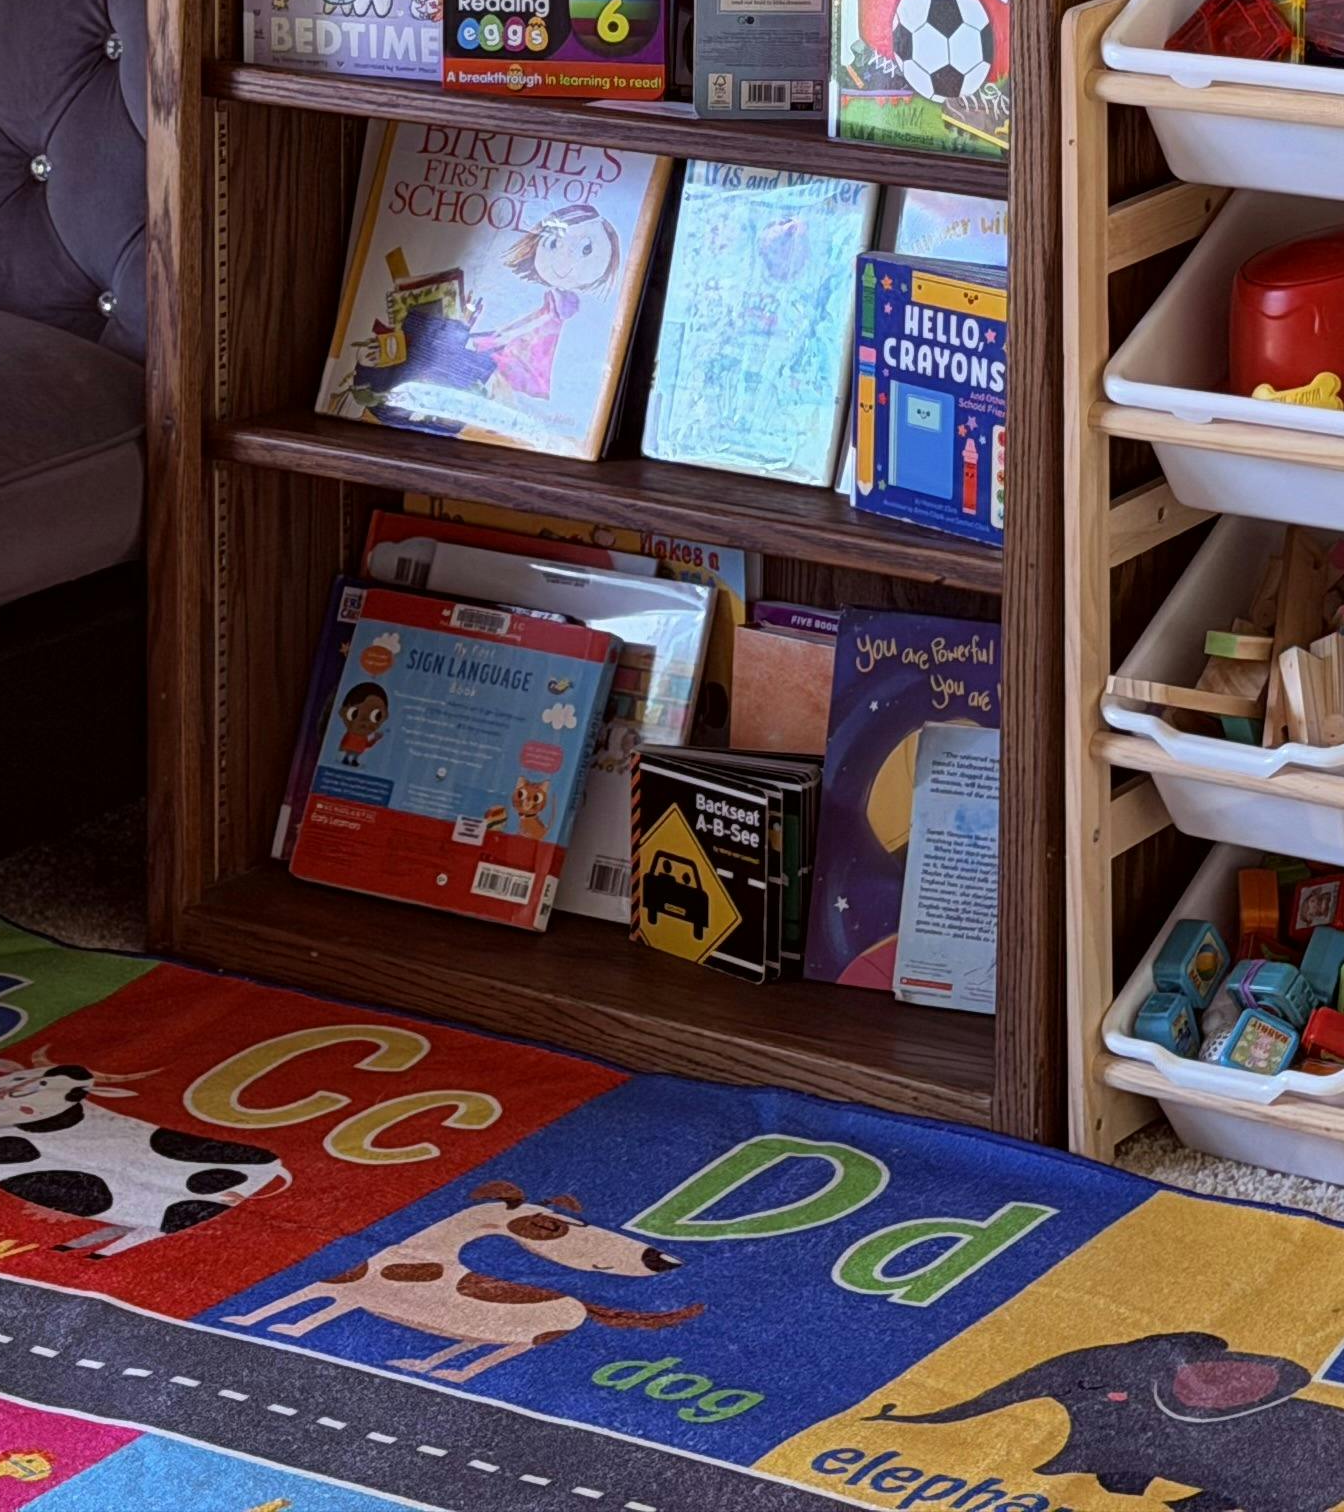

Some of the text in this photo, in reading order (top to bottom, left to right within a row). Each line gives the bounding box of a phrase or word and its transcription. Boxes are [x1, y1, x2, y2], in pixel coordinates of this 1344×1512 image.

[270, 17, 442, 64] BEDTIME
[462, 22, 544, 47] eggs
[446, 71, 662, 90] A breakthrough in learning to read!
[417, 125, 623, 183] BIRDIES
[424, 159, 603, 205] FIRST DAY OF
[746, 168, 779, 190] and
[388, 181, 536, 234] SCHOOL
[904, 304, 985, 353] HELLO,
[883, 337, 1006, 393] CRAYONS
[959, 397, 986, 413] School
[791, 615, 813, 627] FIVE
[406, 648, 443, 676] SIGN
[448, 656, 534, 692] LANGUAGE
[902, 647, 929, 670] are
[931, 635, 994, 665] Powerful
[968, 690, 993, 712] are
[695, 793, 761, 827] Backseat
[695, 814, 760, 848] A-B-See
[183, 1021, 505, 1165] Cc
[622, 1133, 1060, 1308] Dd
[590, 1356, 765, 1424] dog
[810, 1447, 1074, 1512] elepha
